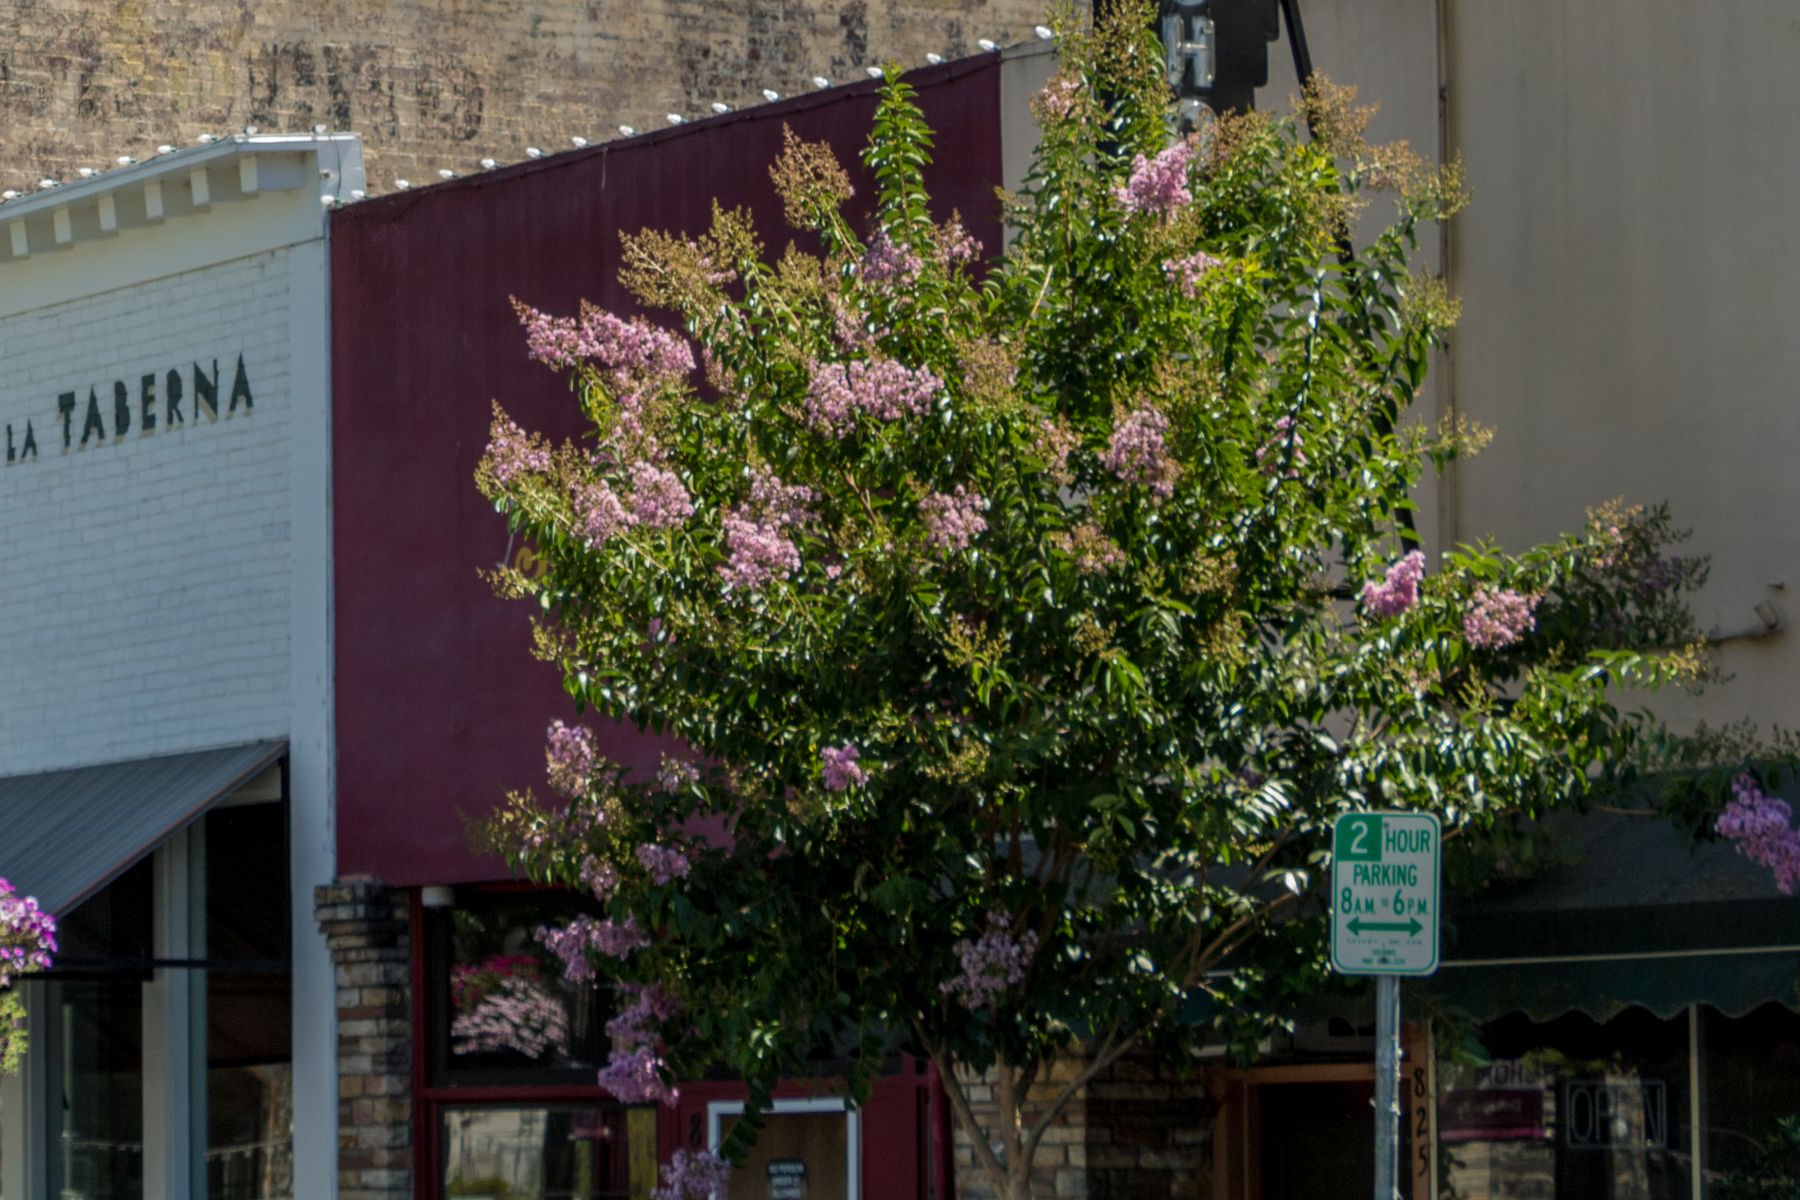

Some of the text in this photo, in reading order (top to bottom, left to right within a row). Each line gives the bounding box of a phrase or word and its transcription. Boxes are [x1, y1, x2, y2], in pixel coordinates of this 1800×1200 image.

[7, 353, 254, 463] LA TABERNA
[1351, 821, 1431, 854] 2 HOUR
[1353, 864, 1418, 887] PARKING
[1571, 1086, 1667, 1143] OPN
